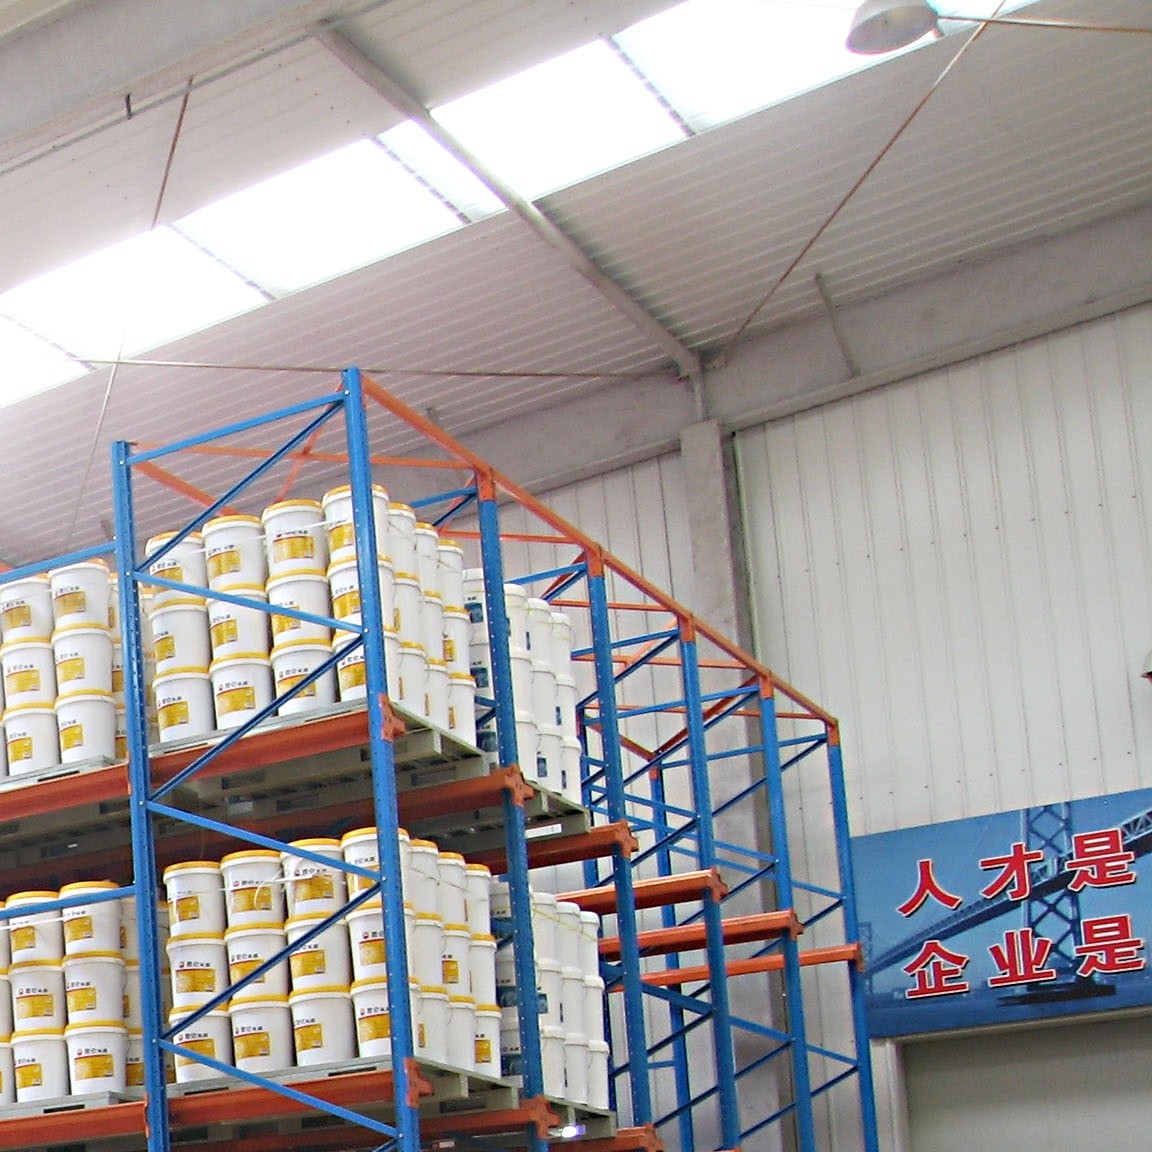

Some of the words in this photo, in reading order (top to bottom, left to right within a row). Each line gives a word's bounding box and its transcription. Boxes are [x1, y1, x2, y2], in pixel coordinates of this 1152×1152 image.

[897, 827, 1137, 918] 人才是
[902, 913, 1146, 1000] 企业是
